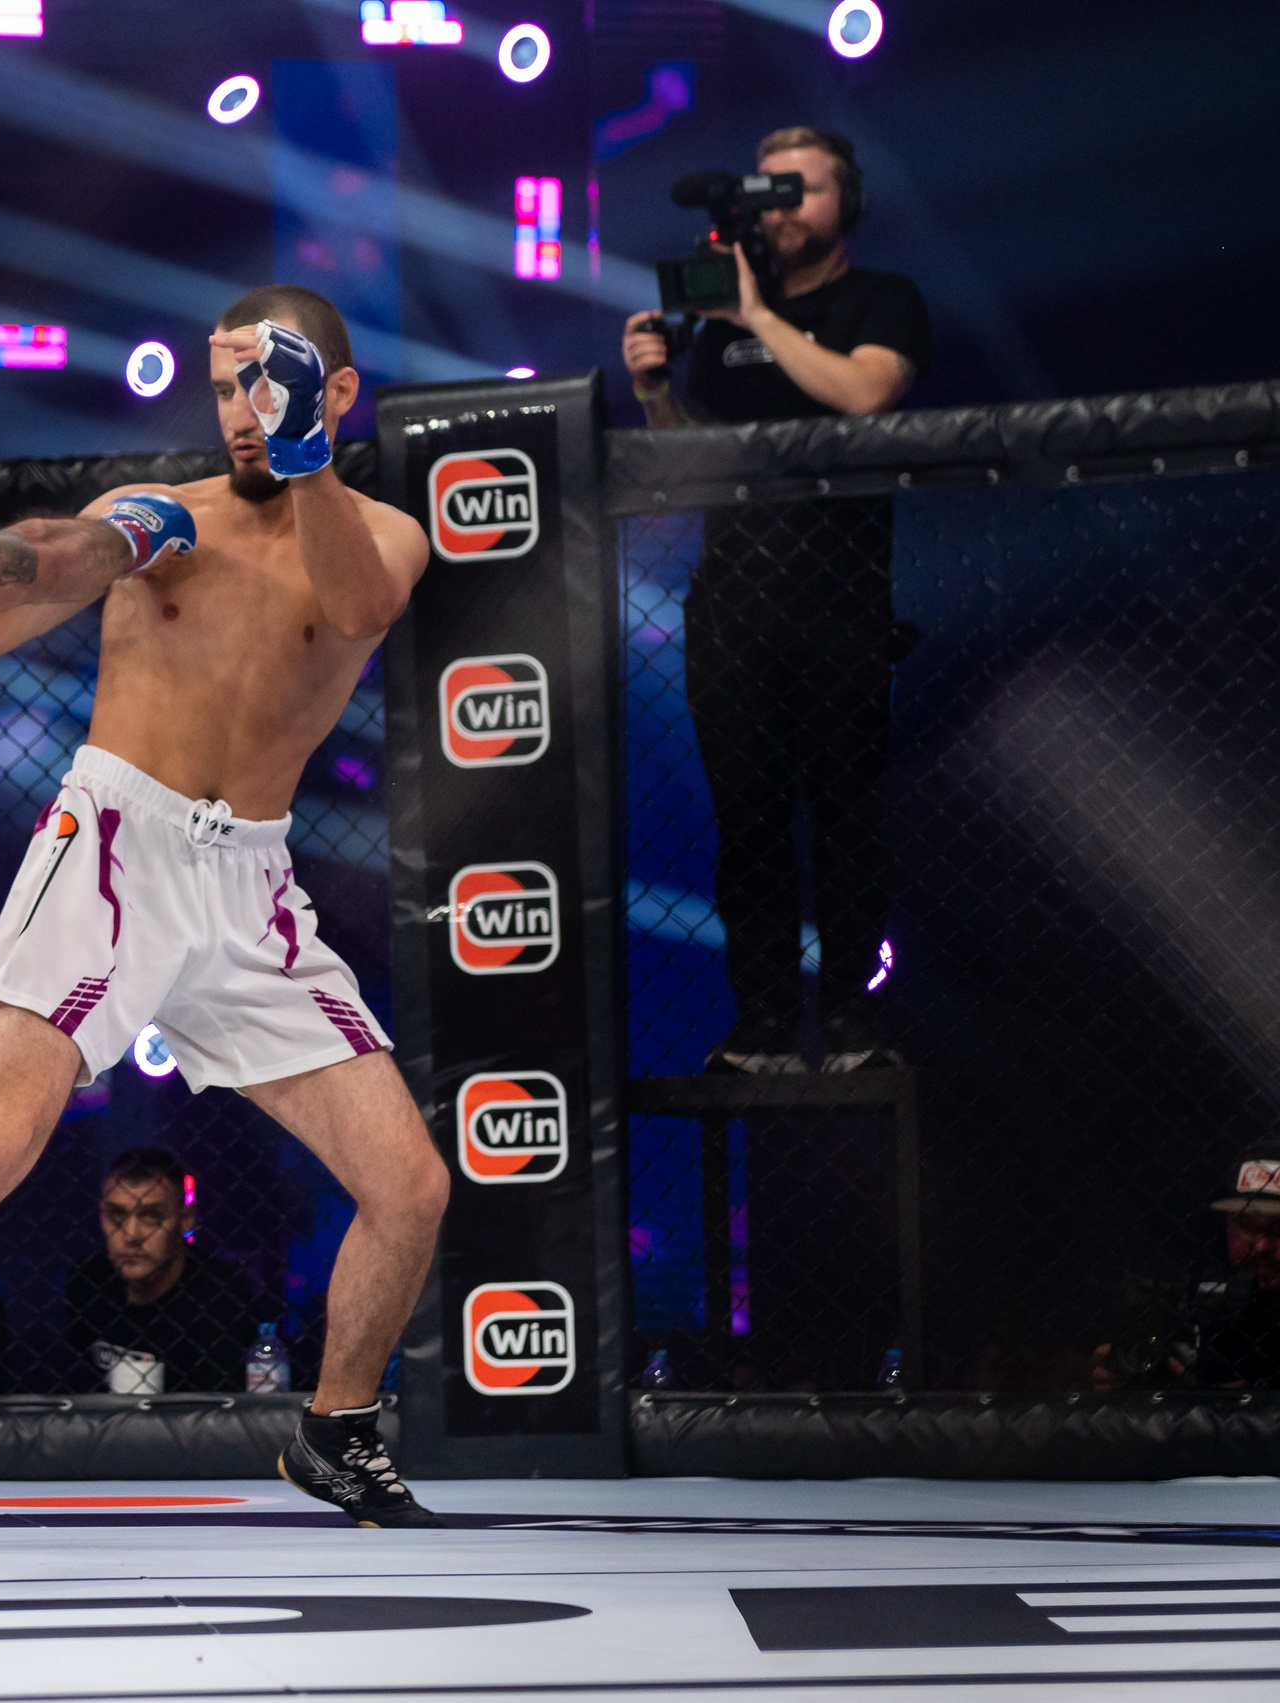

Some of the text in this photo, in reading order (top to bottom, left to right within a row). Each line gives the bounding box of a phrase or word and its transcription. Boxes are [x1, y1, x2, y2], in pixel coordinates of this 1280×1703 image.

[454, 488, 529, 522] Win
[464, 694, 539, 729] Win
[475, 901, 550, 936] Win
[482, 1113, 559, 1145] Win
[489, 1324, 566, 1356] Win
